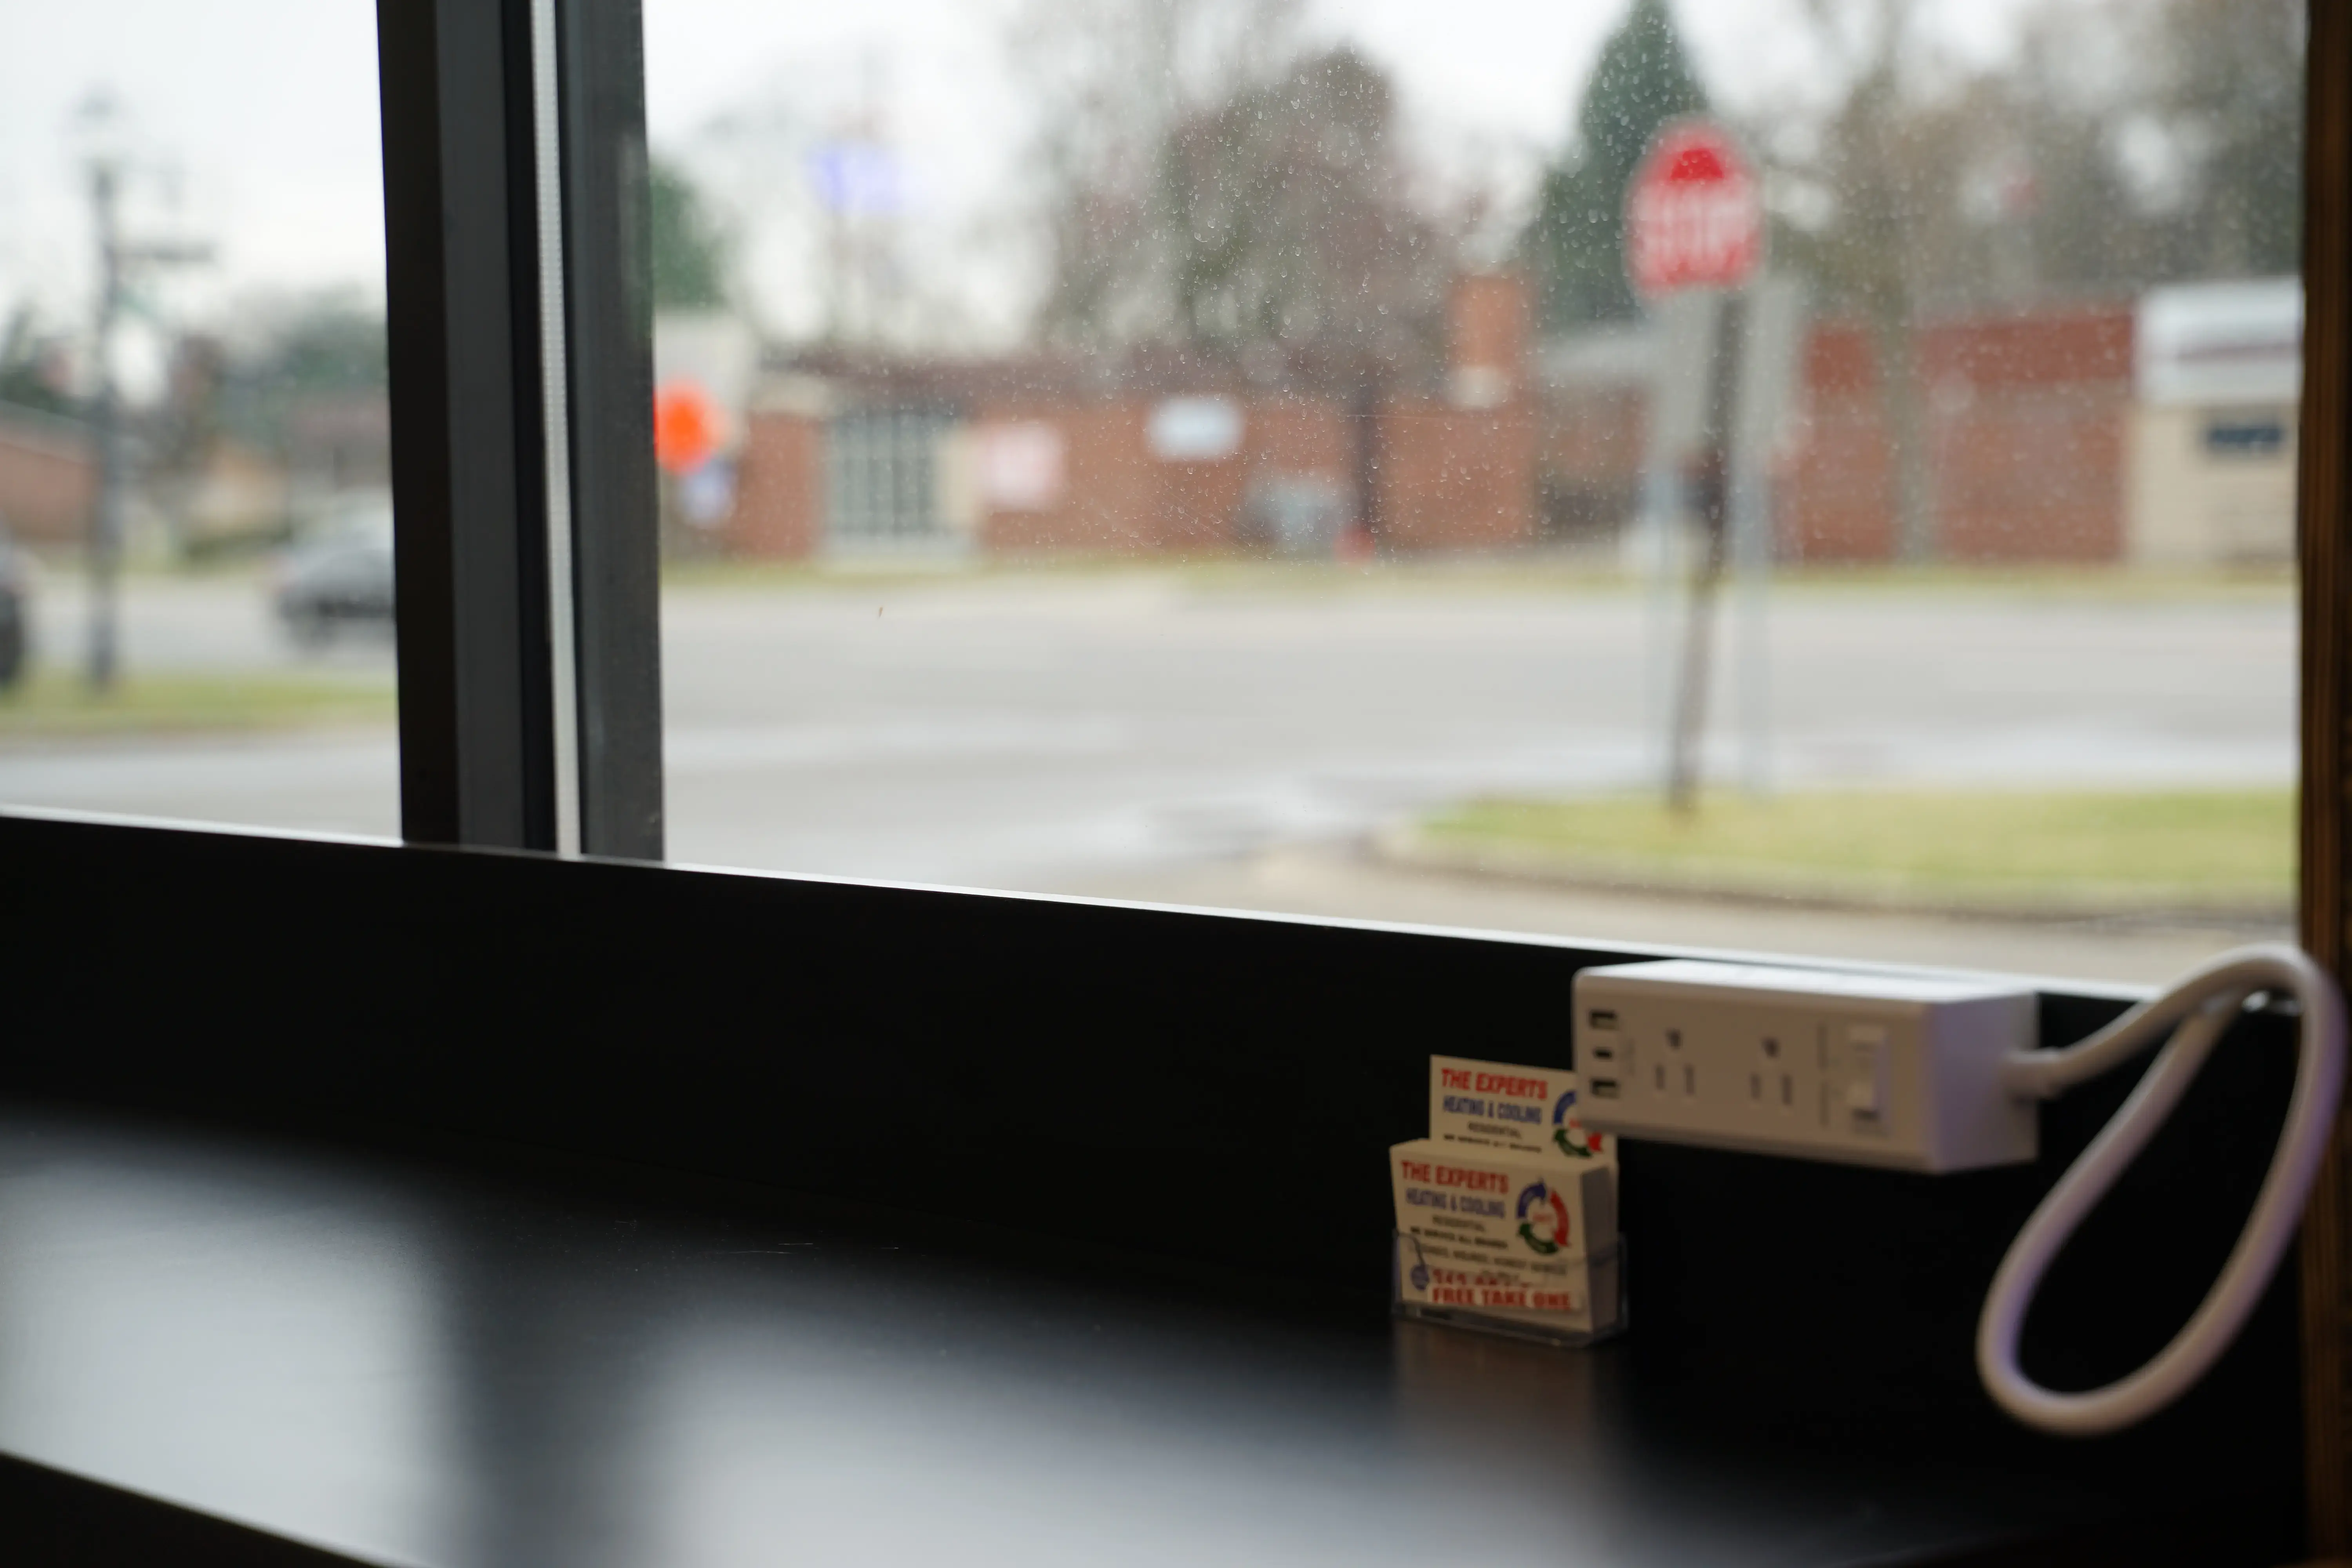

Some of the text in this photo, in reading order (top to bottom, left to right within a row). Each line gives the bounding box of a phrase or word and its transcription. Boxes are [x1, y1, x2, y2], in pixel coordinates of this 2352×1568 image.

[1634, 184, 1757, 276] STOP
[1441, 1068, 1548, 1100] THE EXPERTS
[1443, 1096, 1542, 1124] HEATING & COOLING
[1401, 1161, 1510, 1194] THE EXPERTS
[1405, 1188, 1505, 1219] HEATING & COOLING
[1432, 1287, 1571, 1311] FREE TAKE ONE
